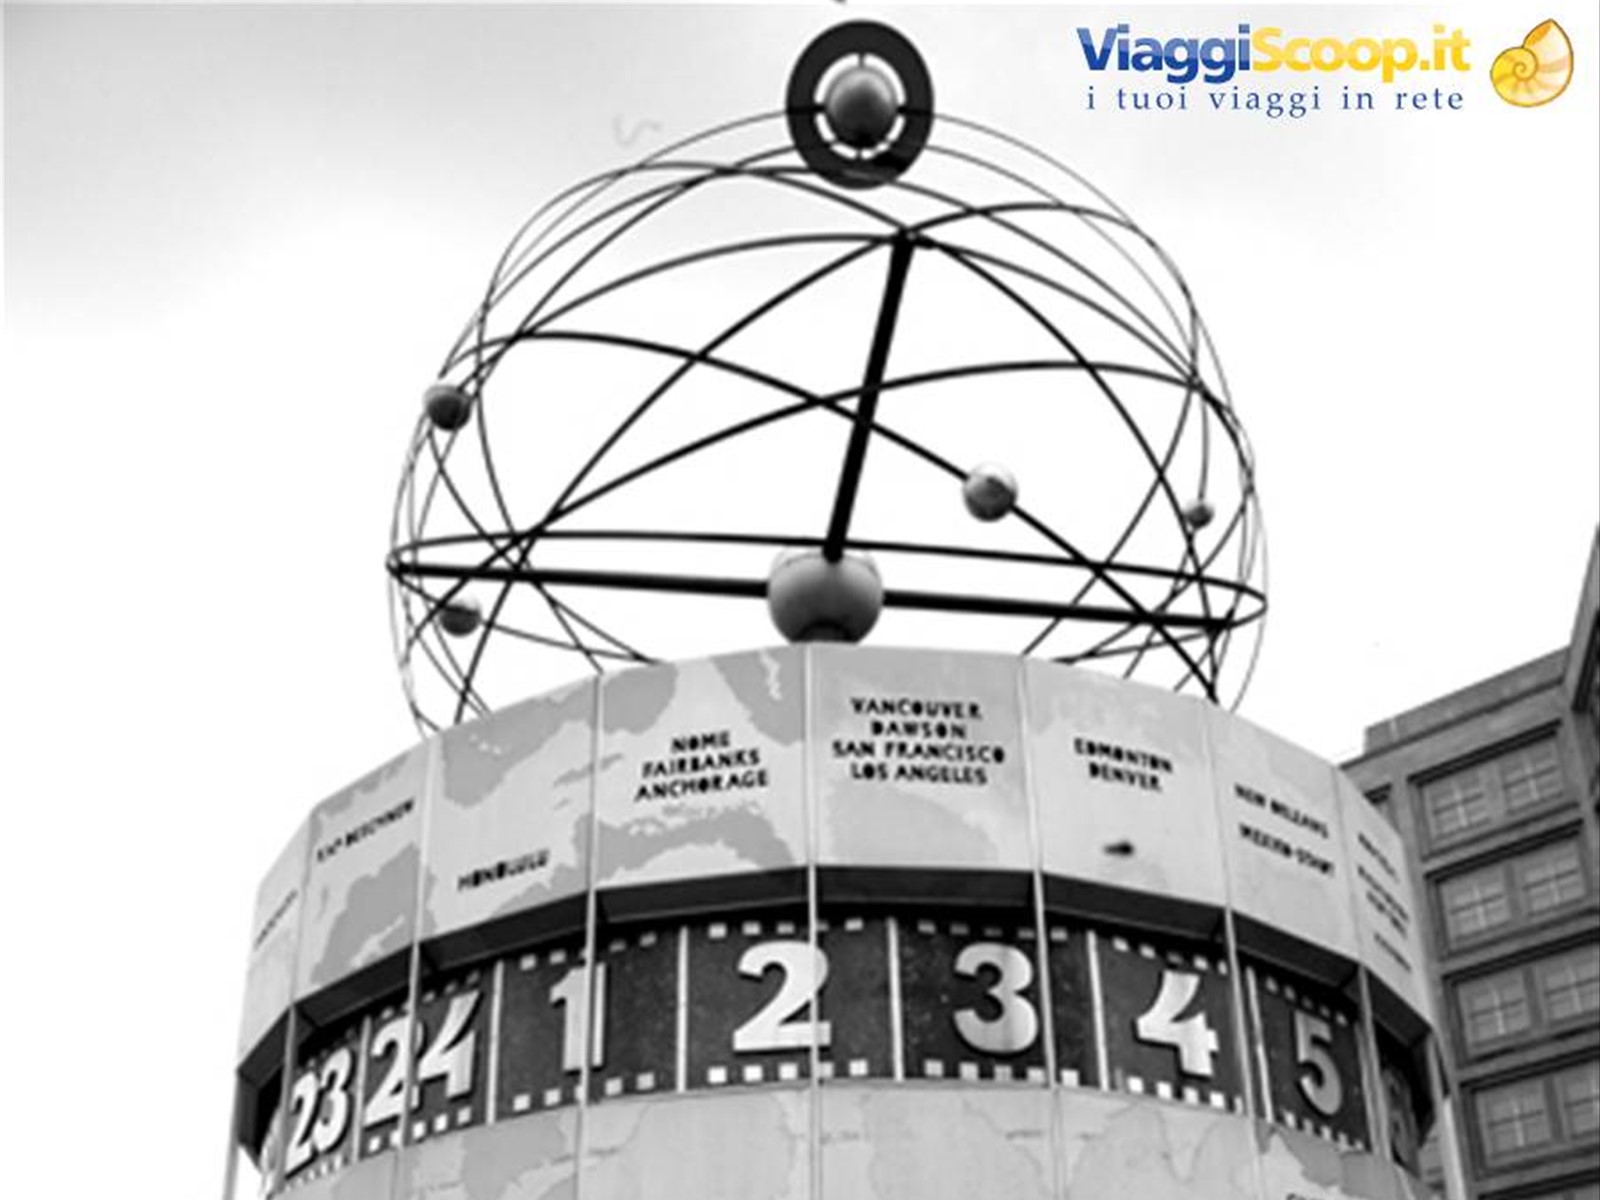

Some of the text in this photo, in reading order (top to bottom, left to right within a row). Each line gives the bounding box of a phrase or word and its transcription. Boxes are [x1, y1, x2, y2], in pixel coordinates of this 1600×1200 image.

[850, 696, 981, 720] VANCOUVER
[672, 732, 731, 753] NOME
[871, 720, 967, 739] DAWSON
[641, 747, 760, 778] FAIRBANKS
[832, 740, 1006, 765] SAN FRANCISCO
[1074, 737, 1174, 774] EDMONTON
[633, 770, 768, 802] ANCHORAGE
[850, 763, 987, 786] LOS ANGELES
[1088, 762, 1163, 793] DENVER
[283, 1048, 350, 1176] 23
[365, 989, 483, 1127] 24
[548, 966, 606, 1073] 1
[733, 940, 831, 1054] 2
[954, 942, 1040, 1053] 3
[1137, 969, 1219, 1077] 4
[1293, 1009, 1344, 1116] 5
